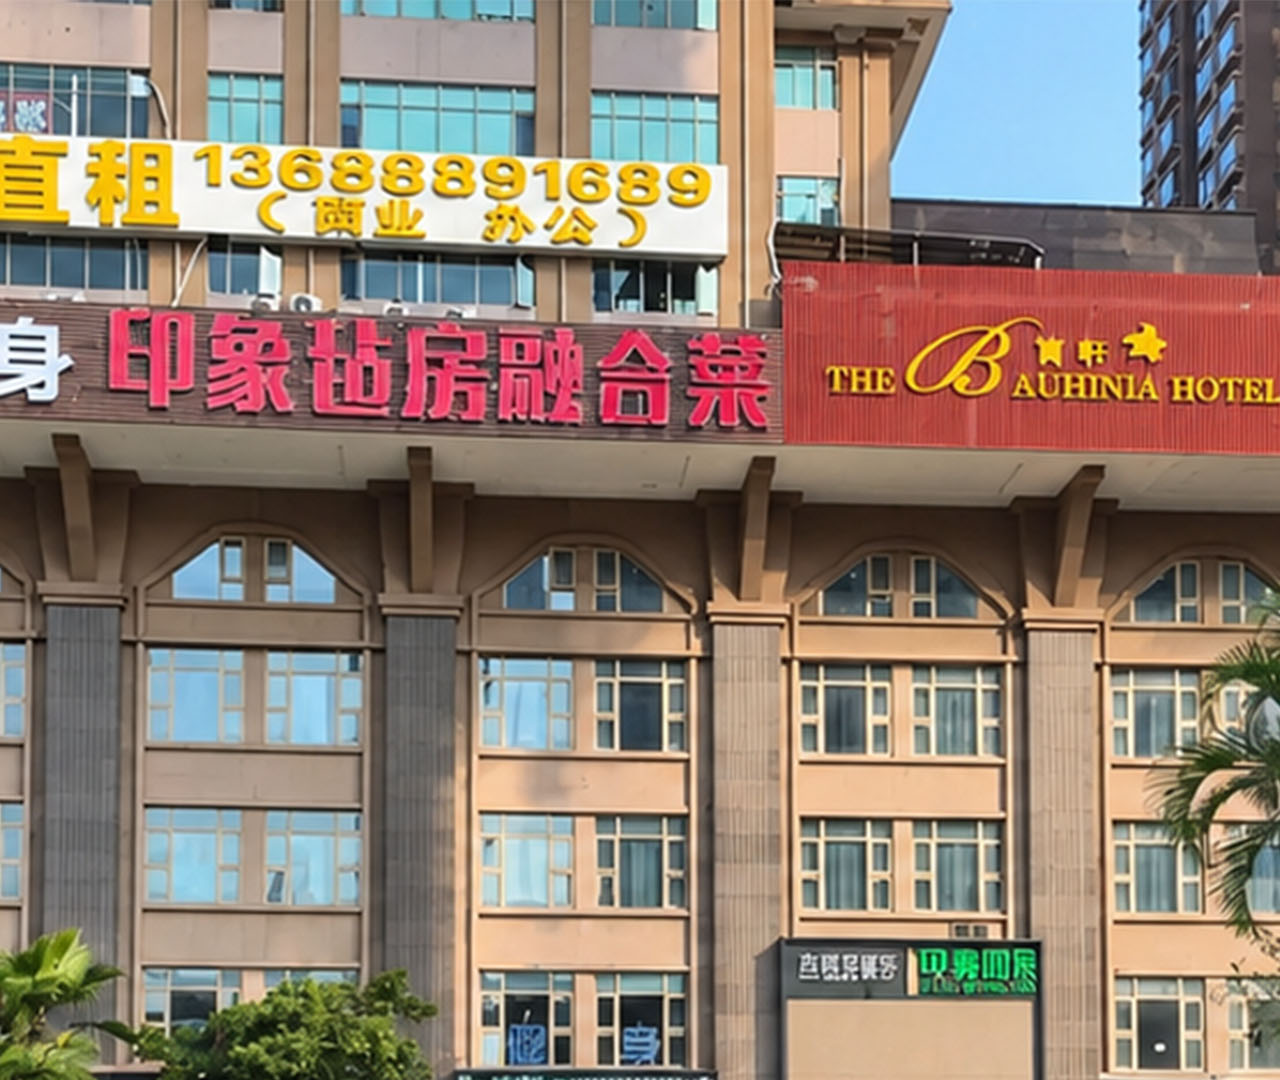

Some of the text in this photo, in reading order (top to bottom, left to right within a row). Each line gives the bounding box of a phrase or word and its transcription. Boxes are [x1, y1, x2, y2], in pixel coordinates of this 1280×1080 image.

[194, 144, 712, 208] 13688891689
[108, 308, 771, 428] 印象毡房融合菜
[826, 366, 896, 395] THE
